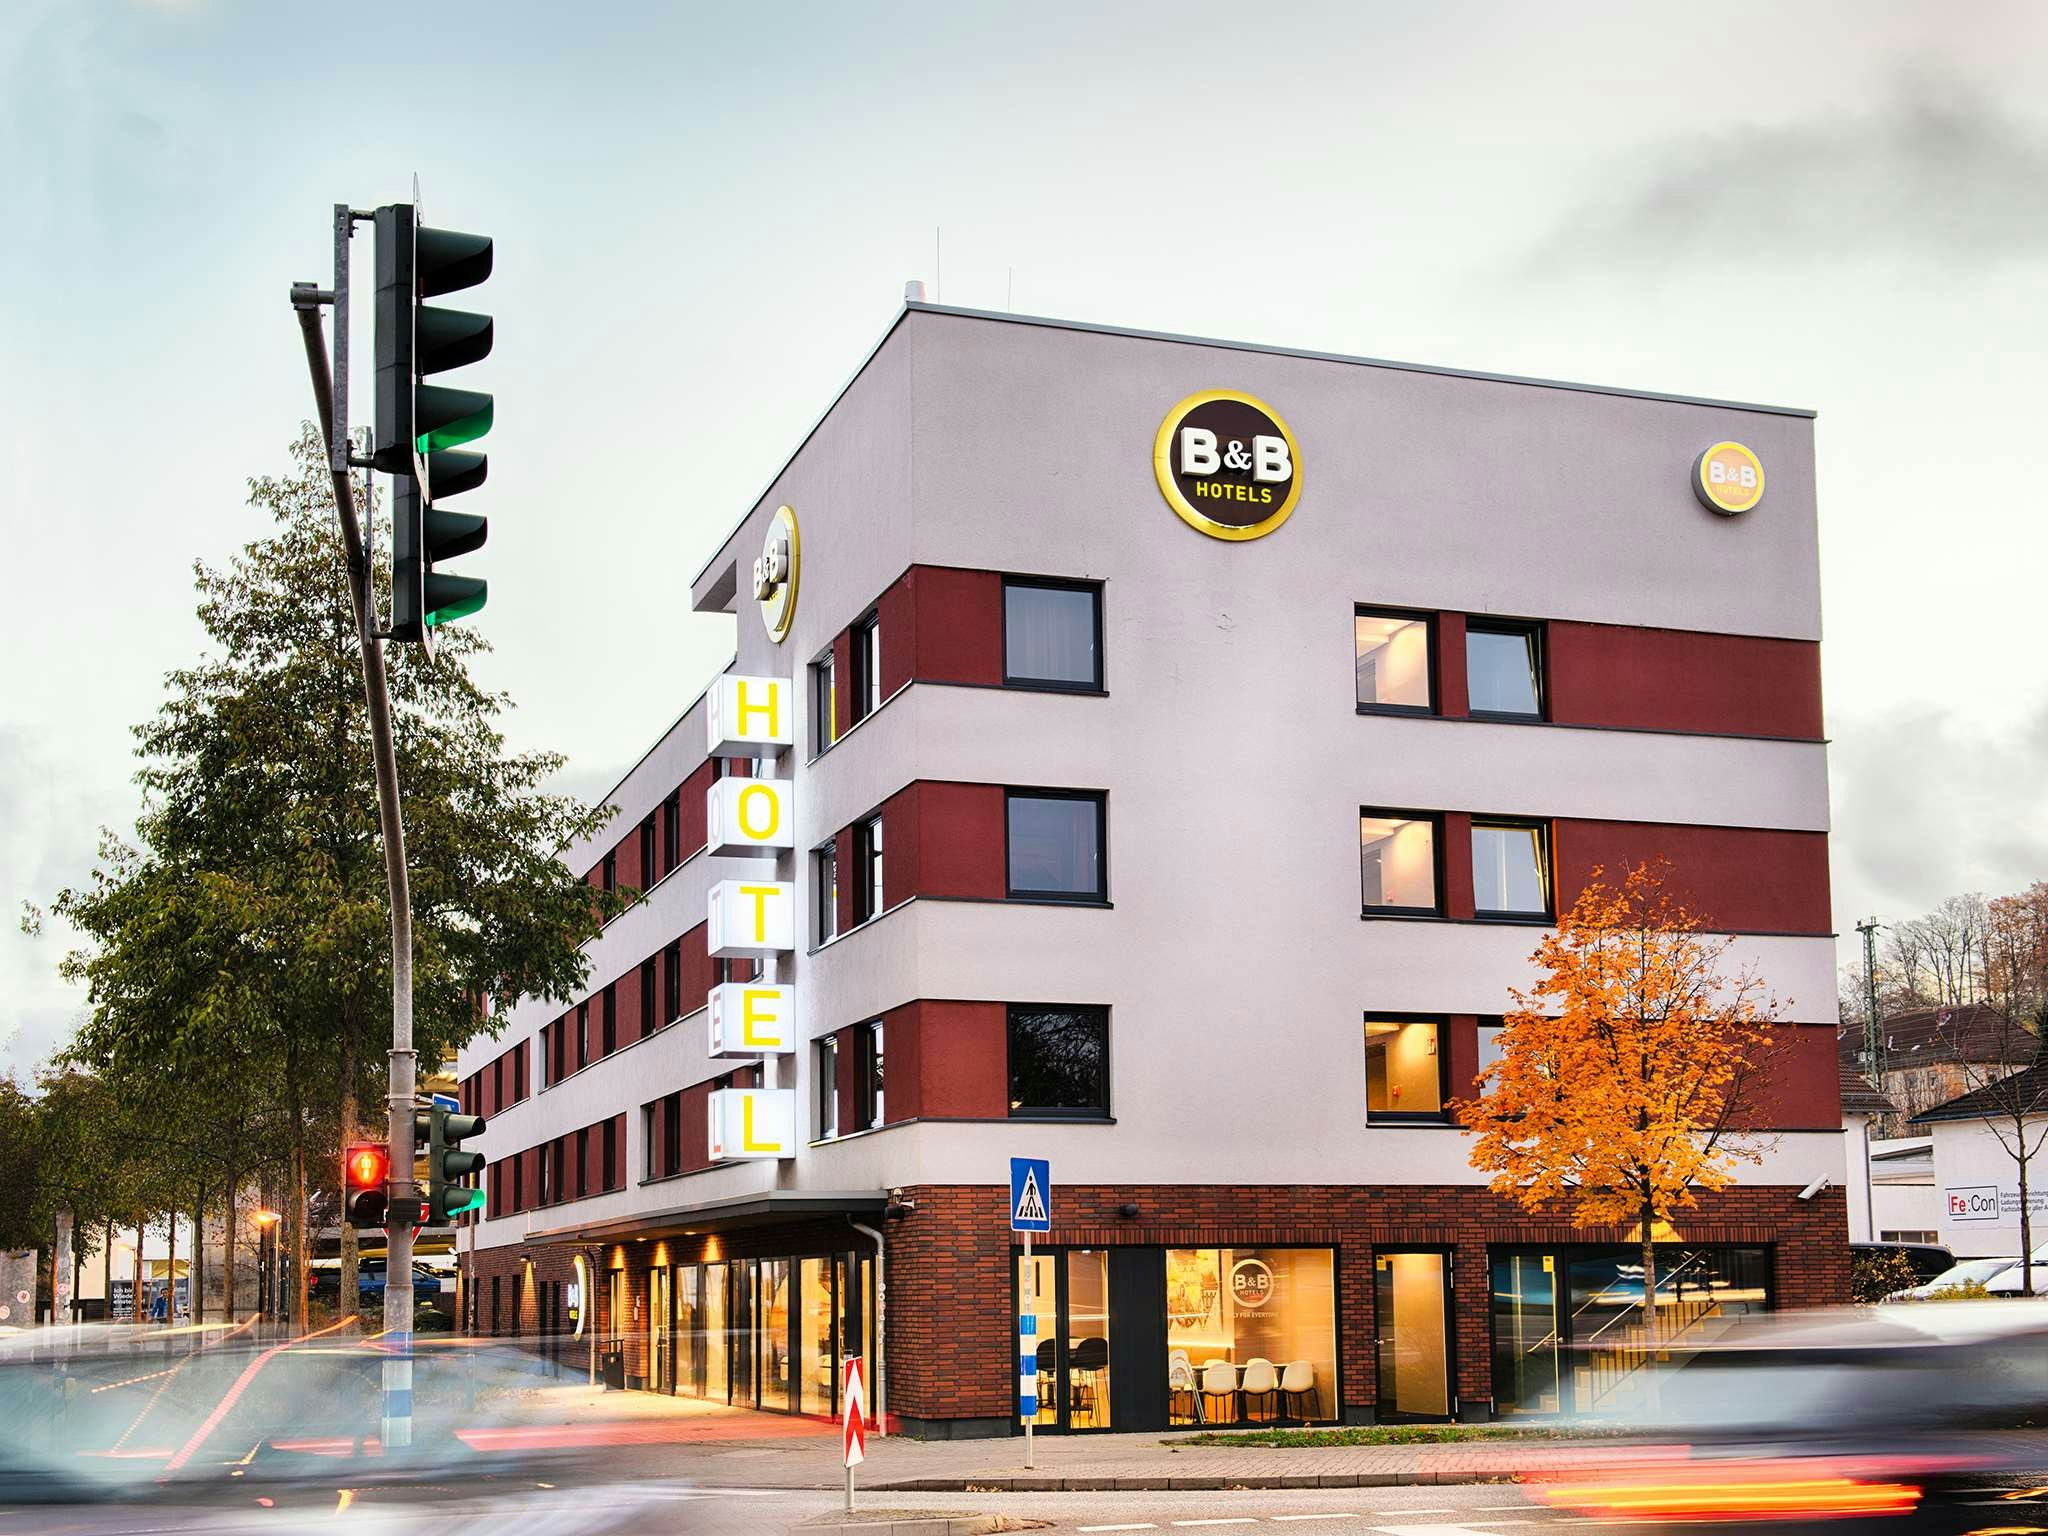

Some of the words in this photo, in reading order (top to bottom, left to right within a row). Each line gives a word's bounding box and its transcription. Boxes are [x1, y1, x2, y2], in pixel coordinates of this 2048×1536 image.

[1181, 427, 1292, 484] B&B
[1710, 461, 1757, 488] B&B
[1197, 482, 1272, 503] HOTELS
[737, 681, 781, 1152] HOTEL
[1951, 1194, 1996, 1213] Fe:Con
[1235, 1274, 1269, 1290] B&B
